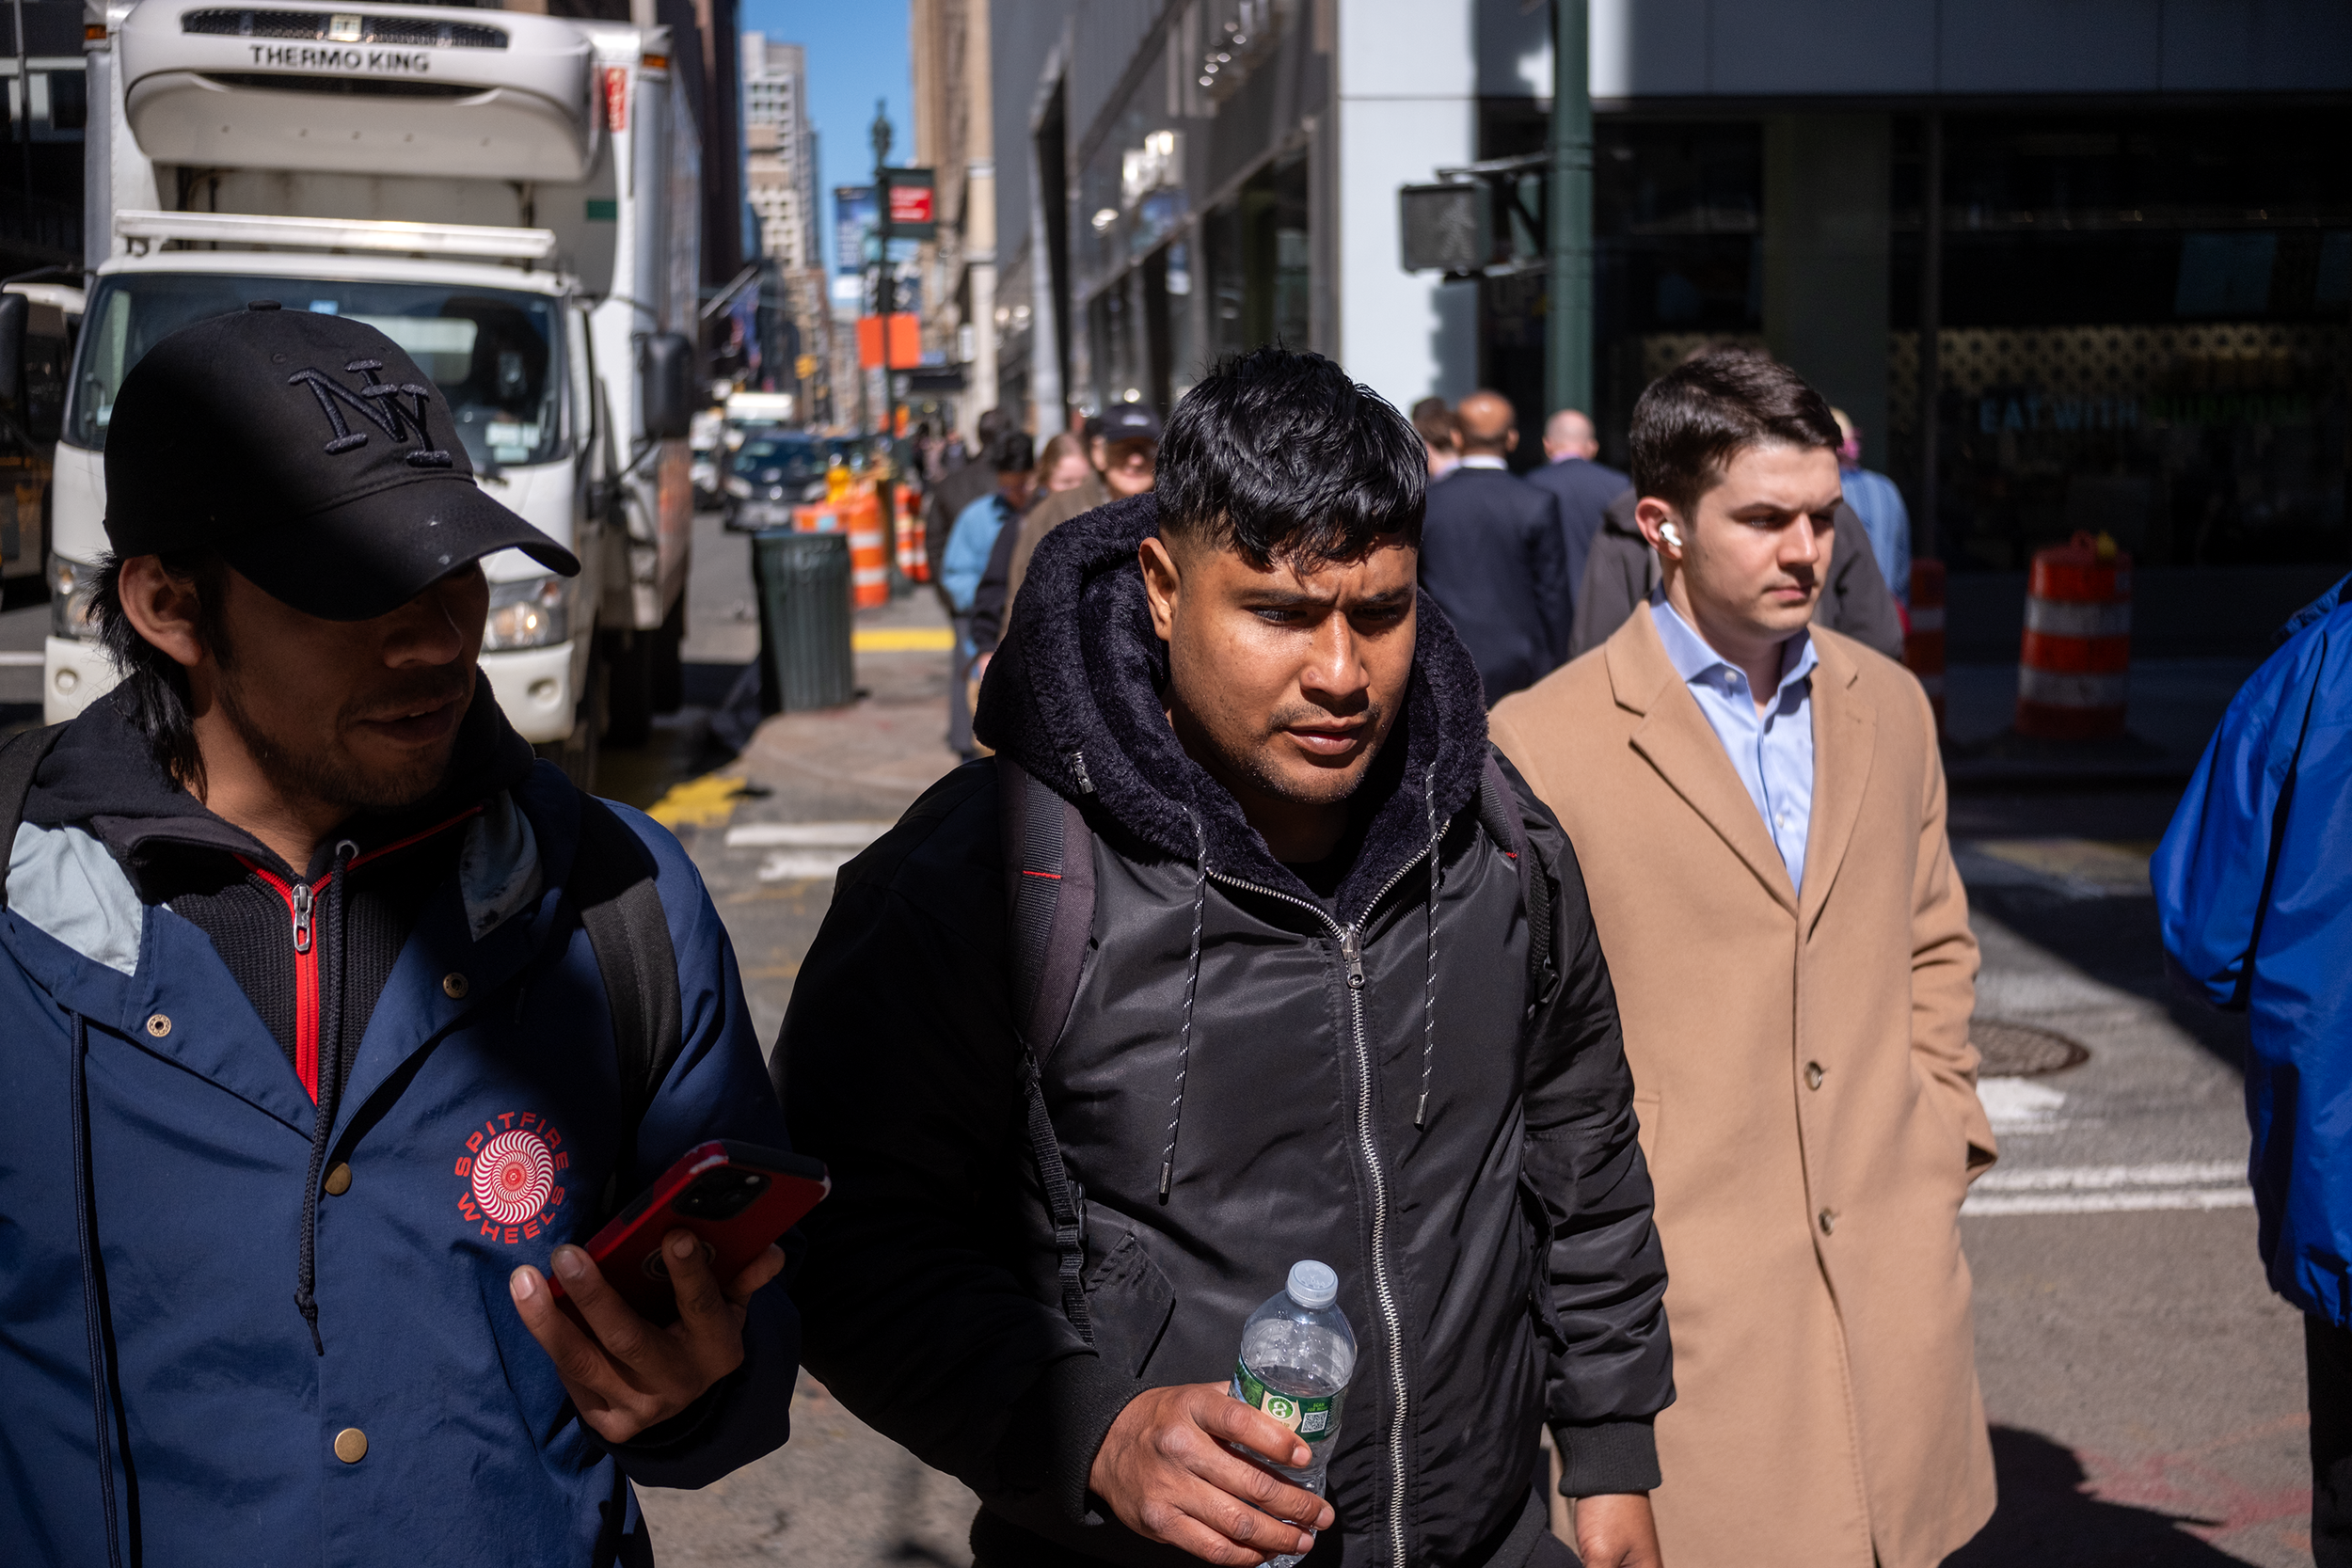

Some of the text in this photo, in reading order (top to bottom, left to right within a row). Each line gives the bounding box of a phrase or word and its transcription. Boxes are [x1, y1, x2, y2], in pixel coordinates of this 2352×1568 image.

[249, 45, 430, 72] THERMO KING
[288, 358, 453, 468] NY
[1979, 395, 2042, 433] EAT
[2054, 399, 2137, 431] WITH
[454, 1111, 569, 1178] SPITFIRE
[457, 1185, 564, 1244] WHEELS
